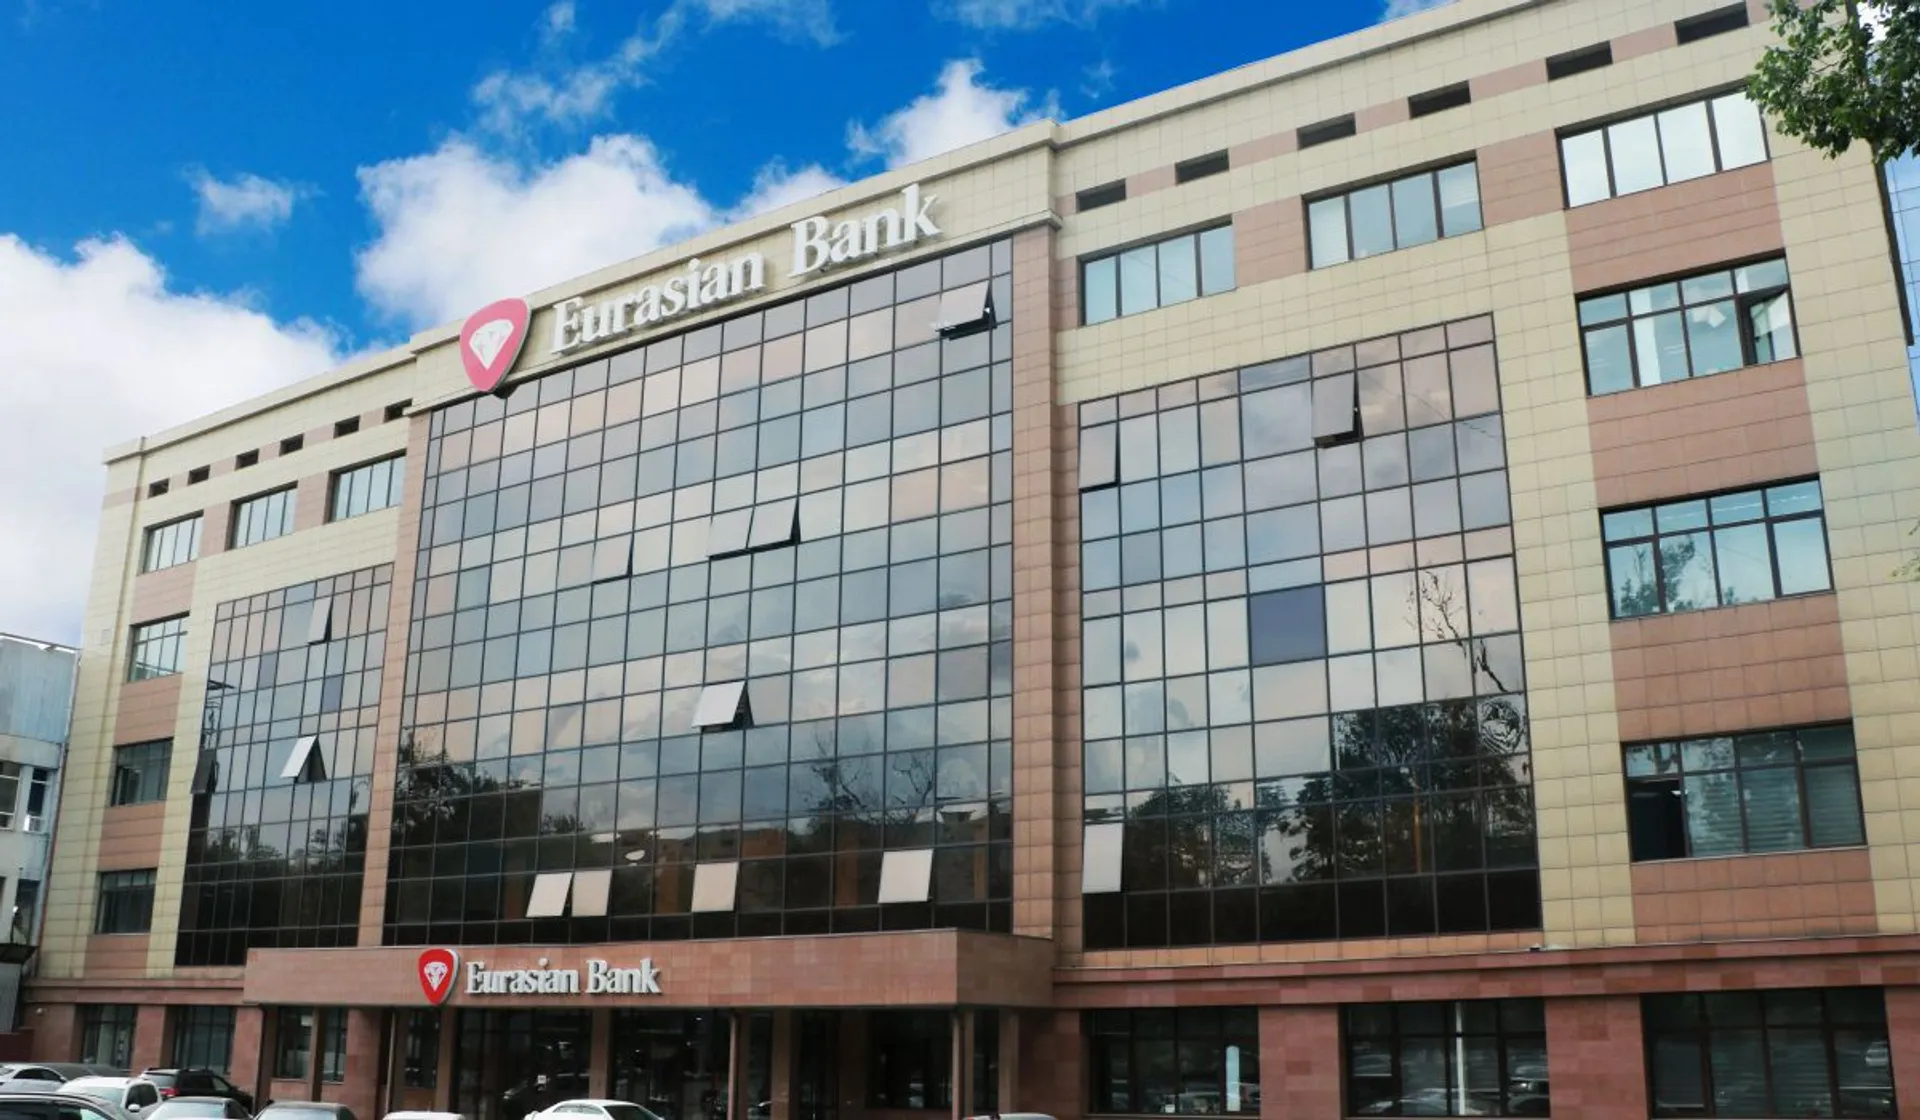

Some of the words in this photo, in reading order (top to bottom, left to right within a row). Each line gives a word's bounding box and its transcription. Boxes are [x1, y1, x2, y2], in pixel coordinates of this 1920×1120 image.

[550, 252, 766, 354] Eurasian
[788, 183, 942, 278] Bank
[465, 958, 580, 994] Eurasian
[586, 958, 662, 994] Bank
